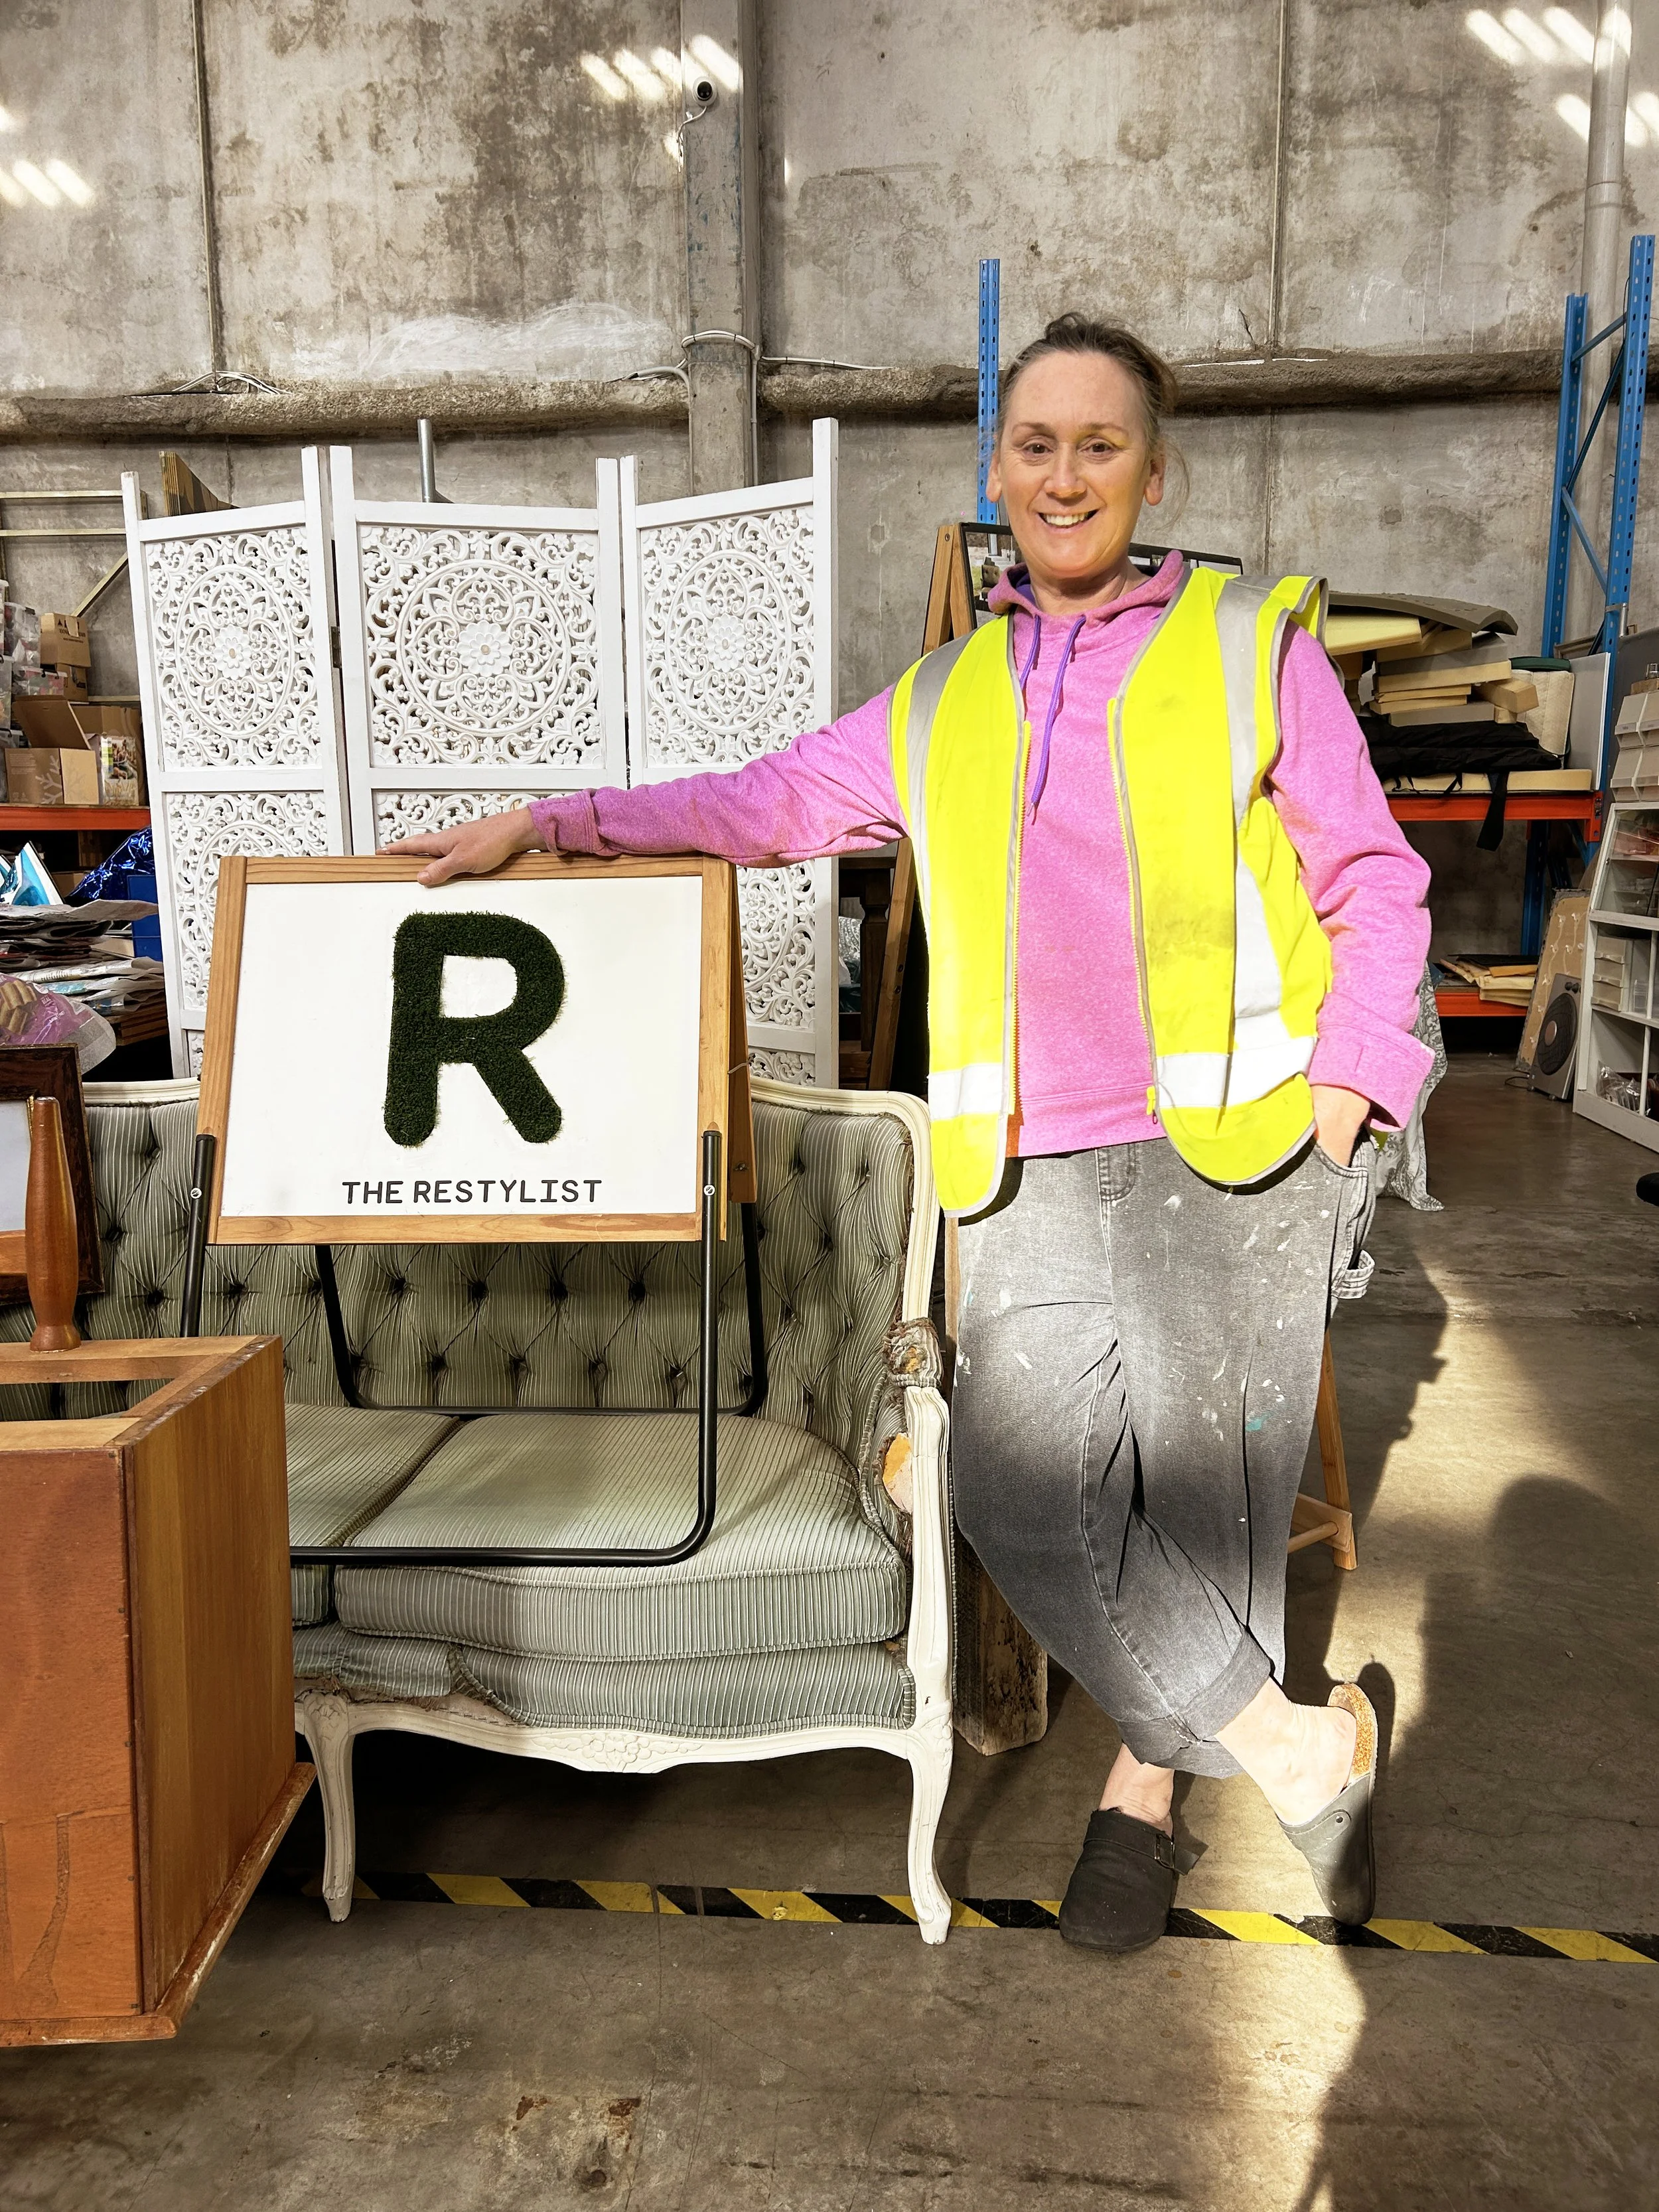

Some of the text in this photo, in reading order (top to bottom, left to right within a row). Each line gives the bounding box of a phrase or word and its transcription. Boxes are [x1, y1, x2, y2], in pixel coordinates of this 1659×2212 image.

[384, 911, 565, 1146] R
[342, 1179, 603, 1204] THE RESTYLIST
